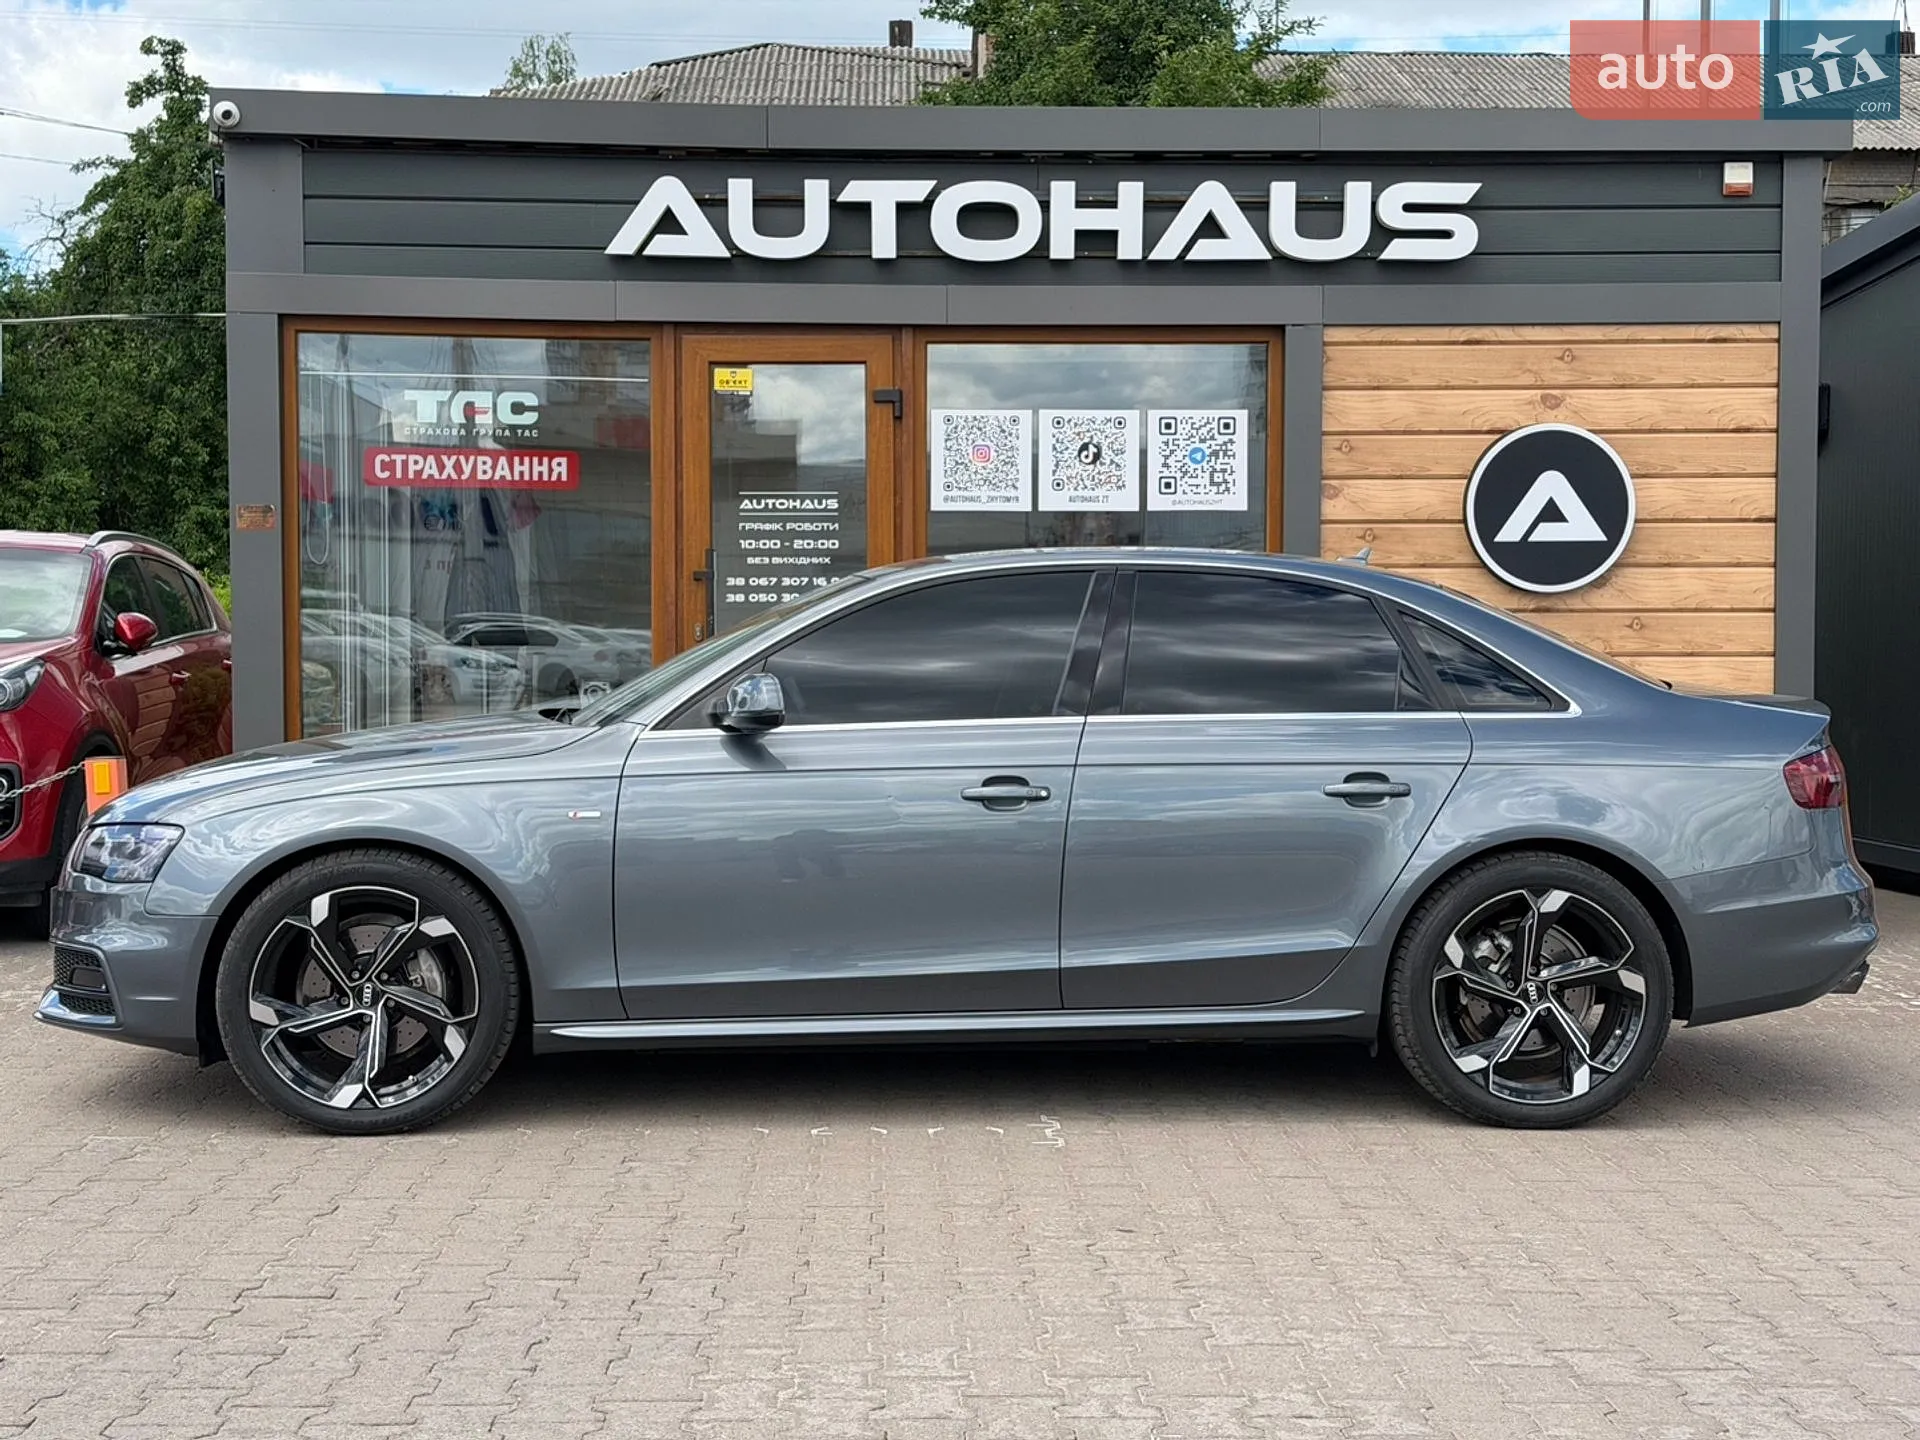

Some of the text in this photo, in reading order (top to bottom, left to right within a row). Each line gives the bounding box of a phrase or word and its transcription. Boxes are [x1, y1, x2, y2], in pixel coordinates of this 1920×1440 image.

[604, 175, 1483, 263] AUTOHAUS
[404, 427, 539, 437] СТРАХОВА ГРУПА ТАС
[374, 454, 568, 481] СТРАХУВАННЯ
[1068, 495, 1100, 503] AUTOHAUS
[739, 499, 839, 509] AUTOHAUS
[1493, 469, 1608, 542] A
[739, 523, 839, 531] ГРАФІК РОБОТИ
[739, 540, 781, 549] 10:00
[793, 540, 839, 549] 20:00
[772, 557, 831, 565] ВИХІДНИХ
[726, 577, 745, 586] 38
[749, 577, 778, 586] 067
[781, 577, 809, 586] 307
[726, 593, 745, 602] 38
[748, 593, 777, 602] 050
